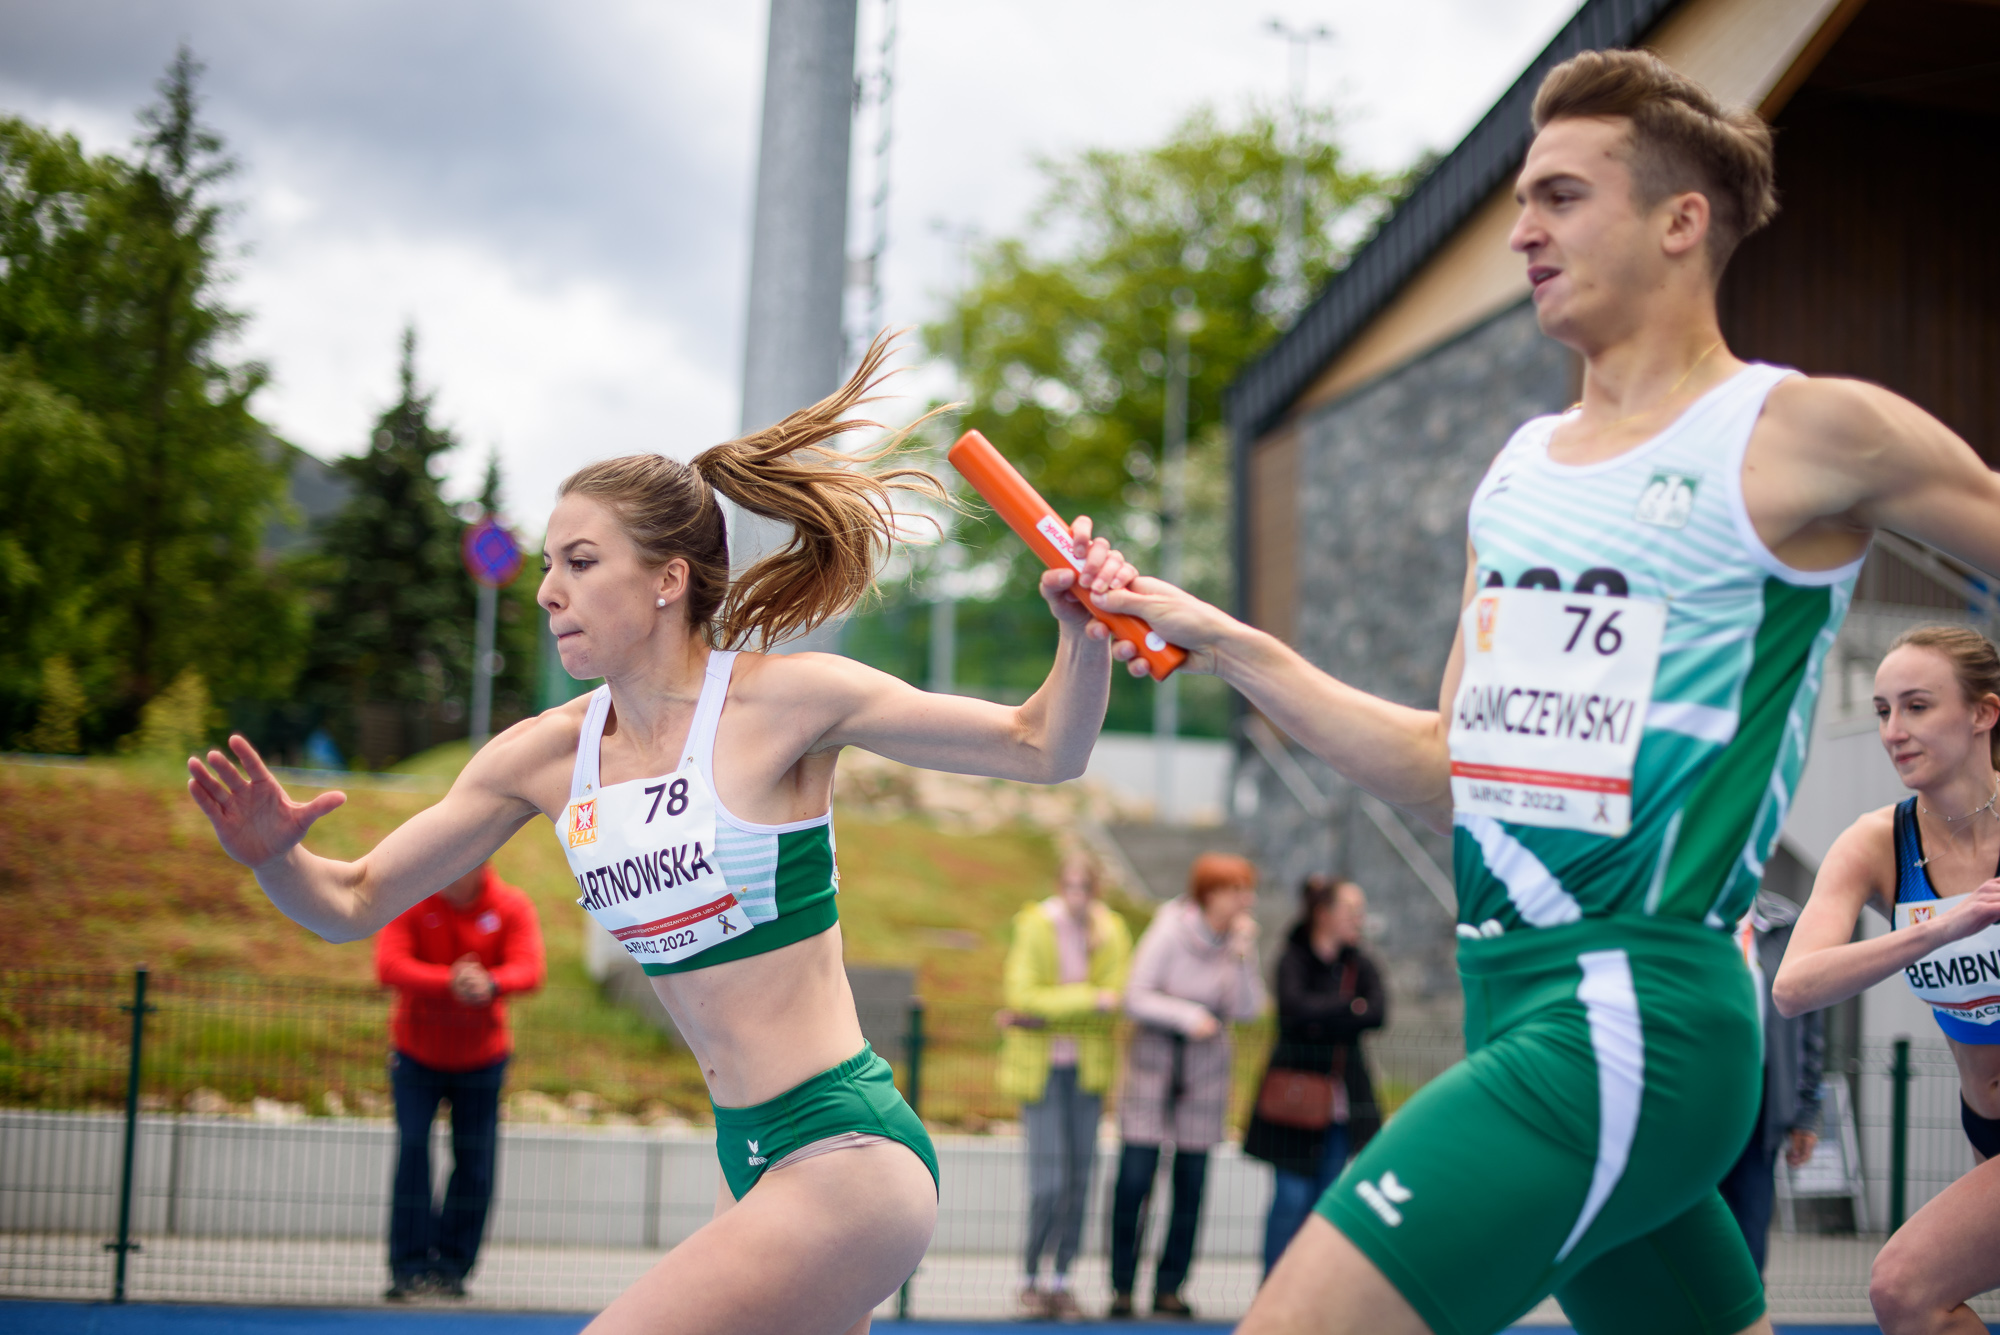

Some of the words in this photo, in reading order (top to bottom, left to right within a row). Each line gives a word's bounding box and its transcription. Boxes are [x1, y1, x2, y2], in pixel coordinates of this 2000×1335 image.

[1044, 523, 1081, 560] olanik
[1564, 606, 1623, 655] 76
[644, 778, 689, 824] 78
[1521, 790, 1567, 812] 2022
[570, 829, 596, 846] PZLA
[575, 841, 713, 911] ARTNOWSKA
[625, 940, 660, 954] ARPACZ
[660, 930, 698, 952] 2022
[1905, 950, 2000, 989] BEMBN
